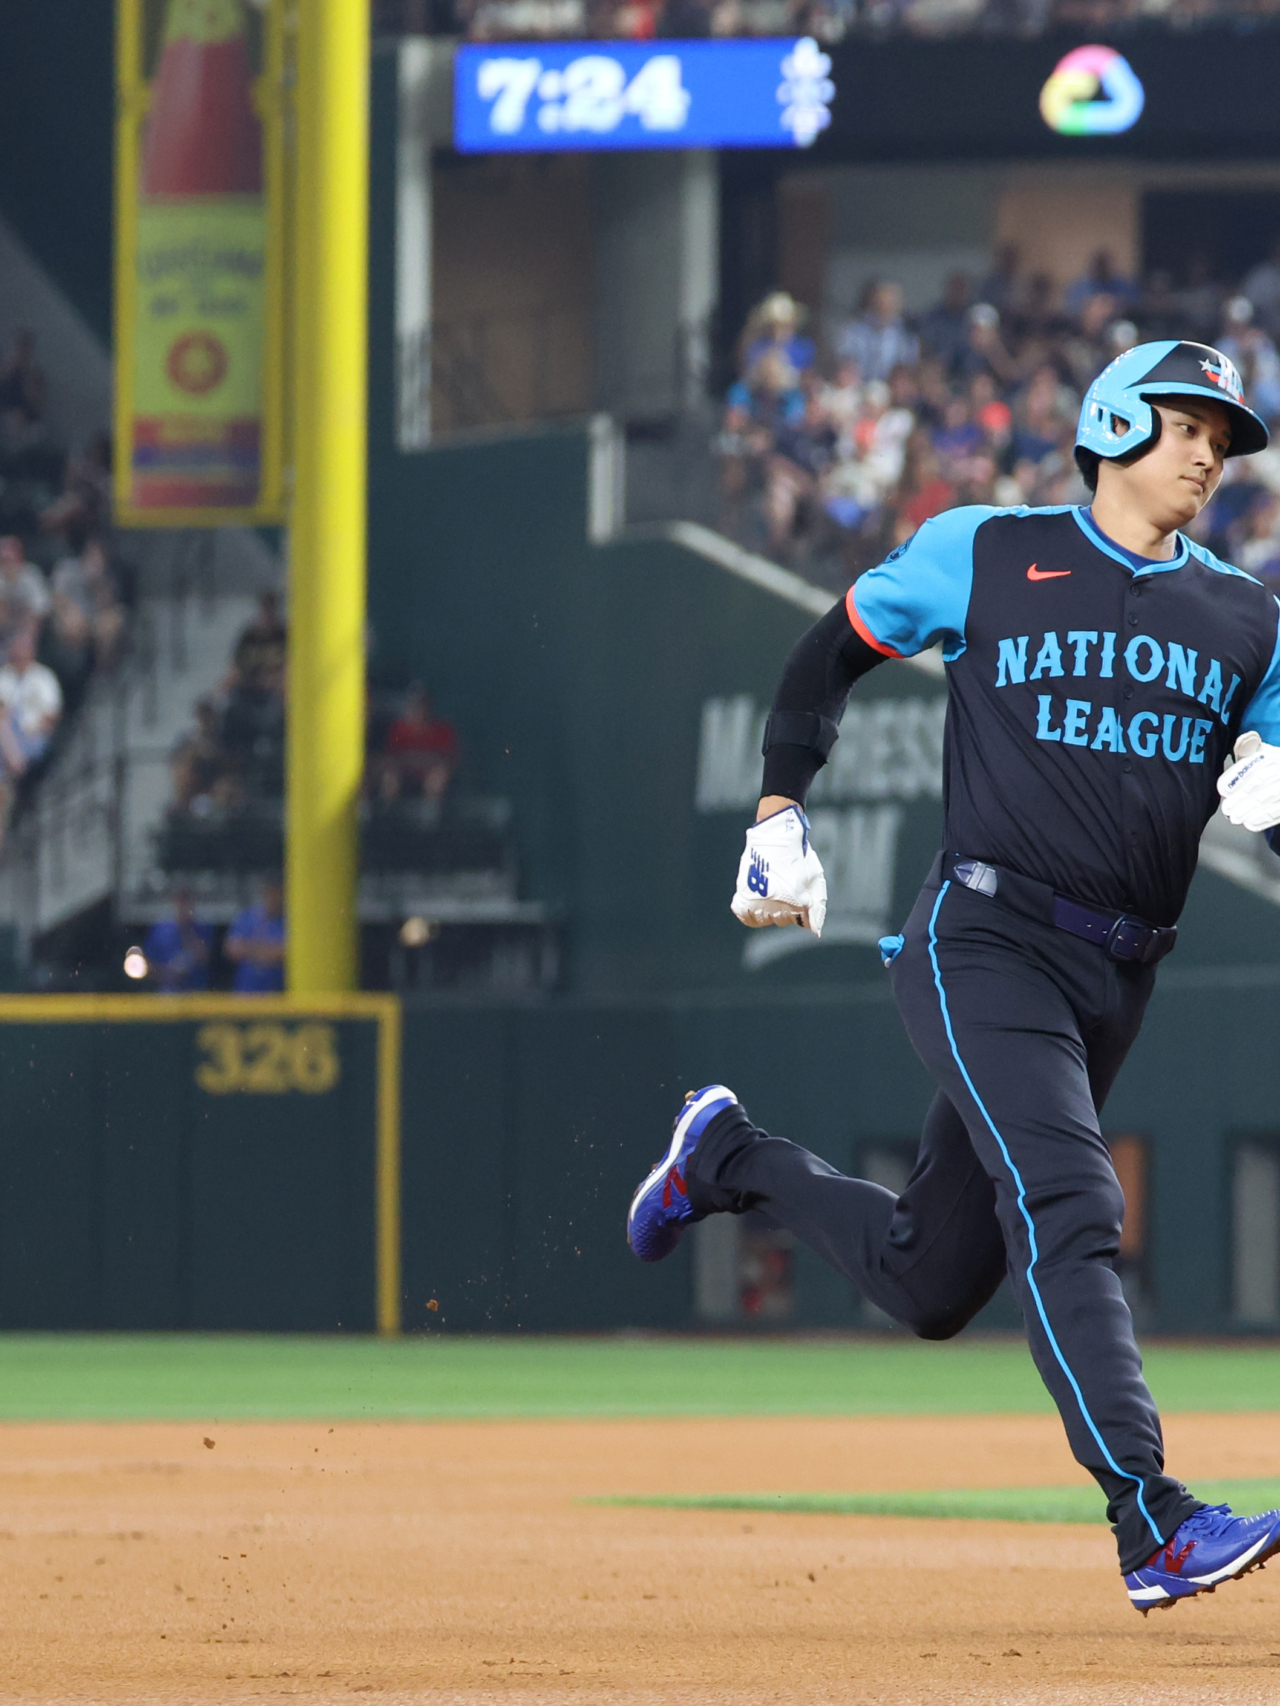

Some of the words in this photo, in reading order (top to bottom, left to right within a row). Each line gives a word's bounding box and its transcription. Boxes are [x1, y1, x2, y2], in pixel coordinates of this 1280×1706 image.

[477, 54, 692, 135] 7:24
[995, 630, 1241, 725] NATIONAL
[1035, 694, 1213, 763] LEAGUE
[196, 1021, 341, 1094] 326
